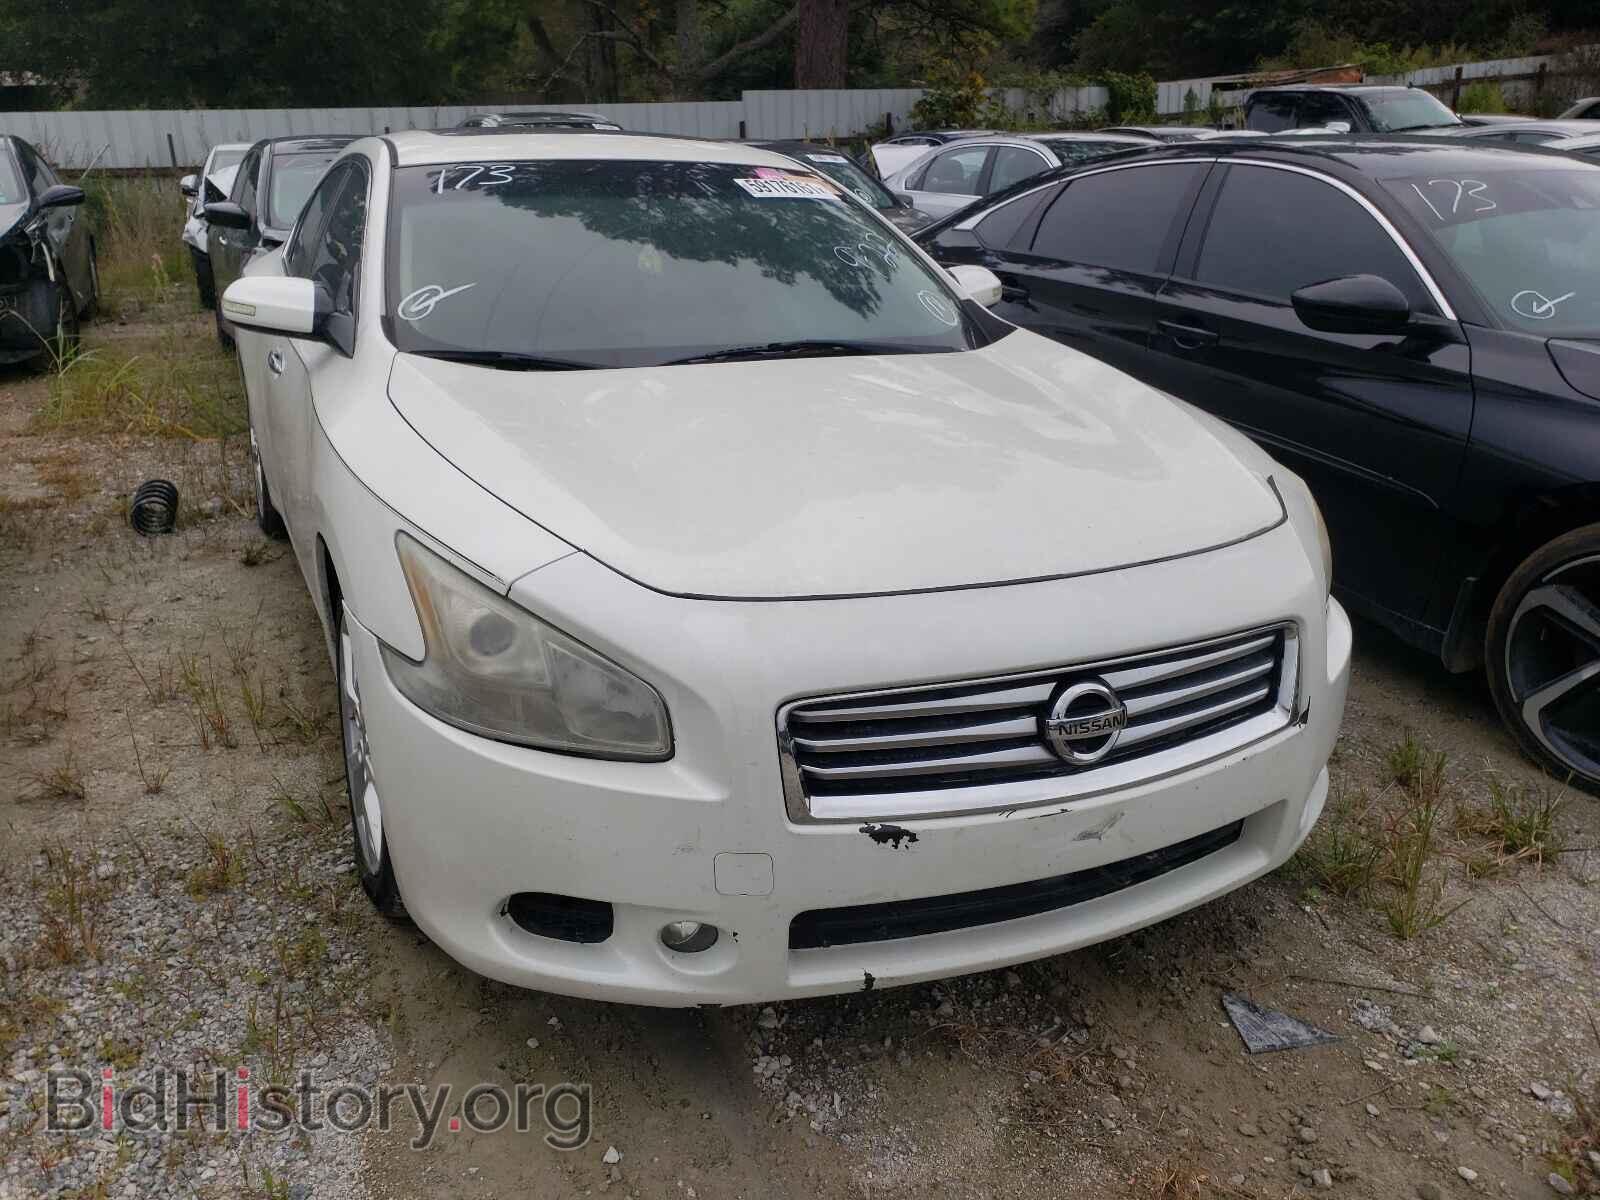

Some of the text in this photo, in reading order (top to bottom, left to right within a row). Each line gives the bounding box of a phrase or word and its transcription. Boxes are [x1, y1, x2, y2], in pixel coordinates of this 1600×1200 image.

[437, 165, 516, 194] 173
[1411, 178, 1497, 222] 173
[1058, 709, 1126, 736] NISSAN
